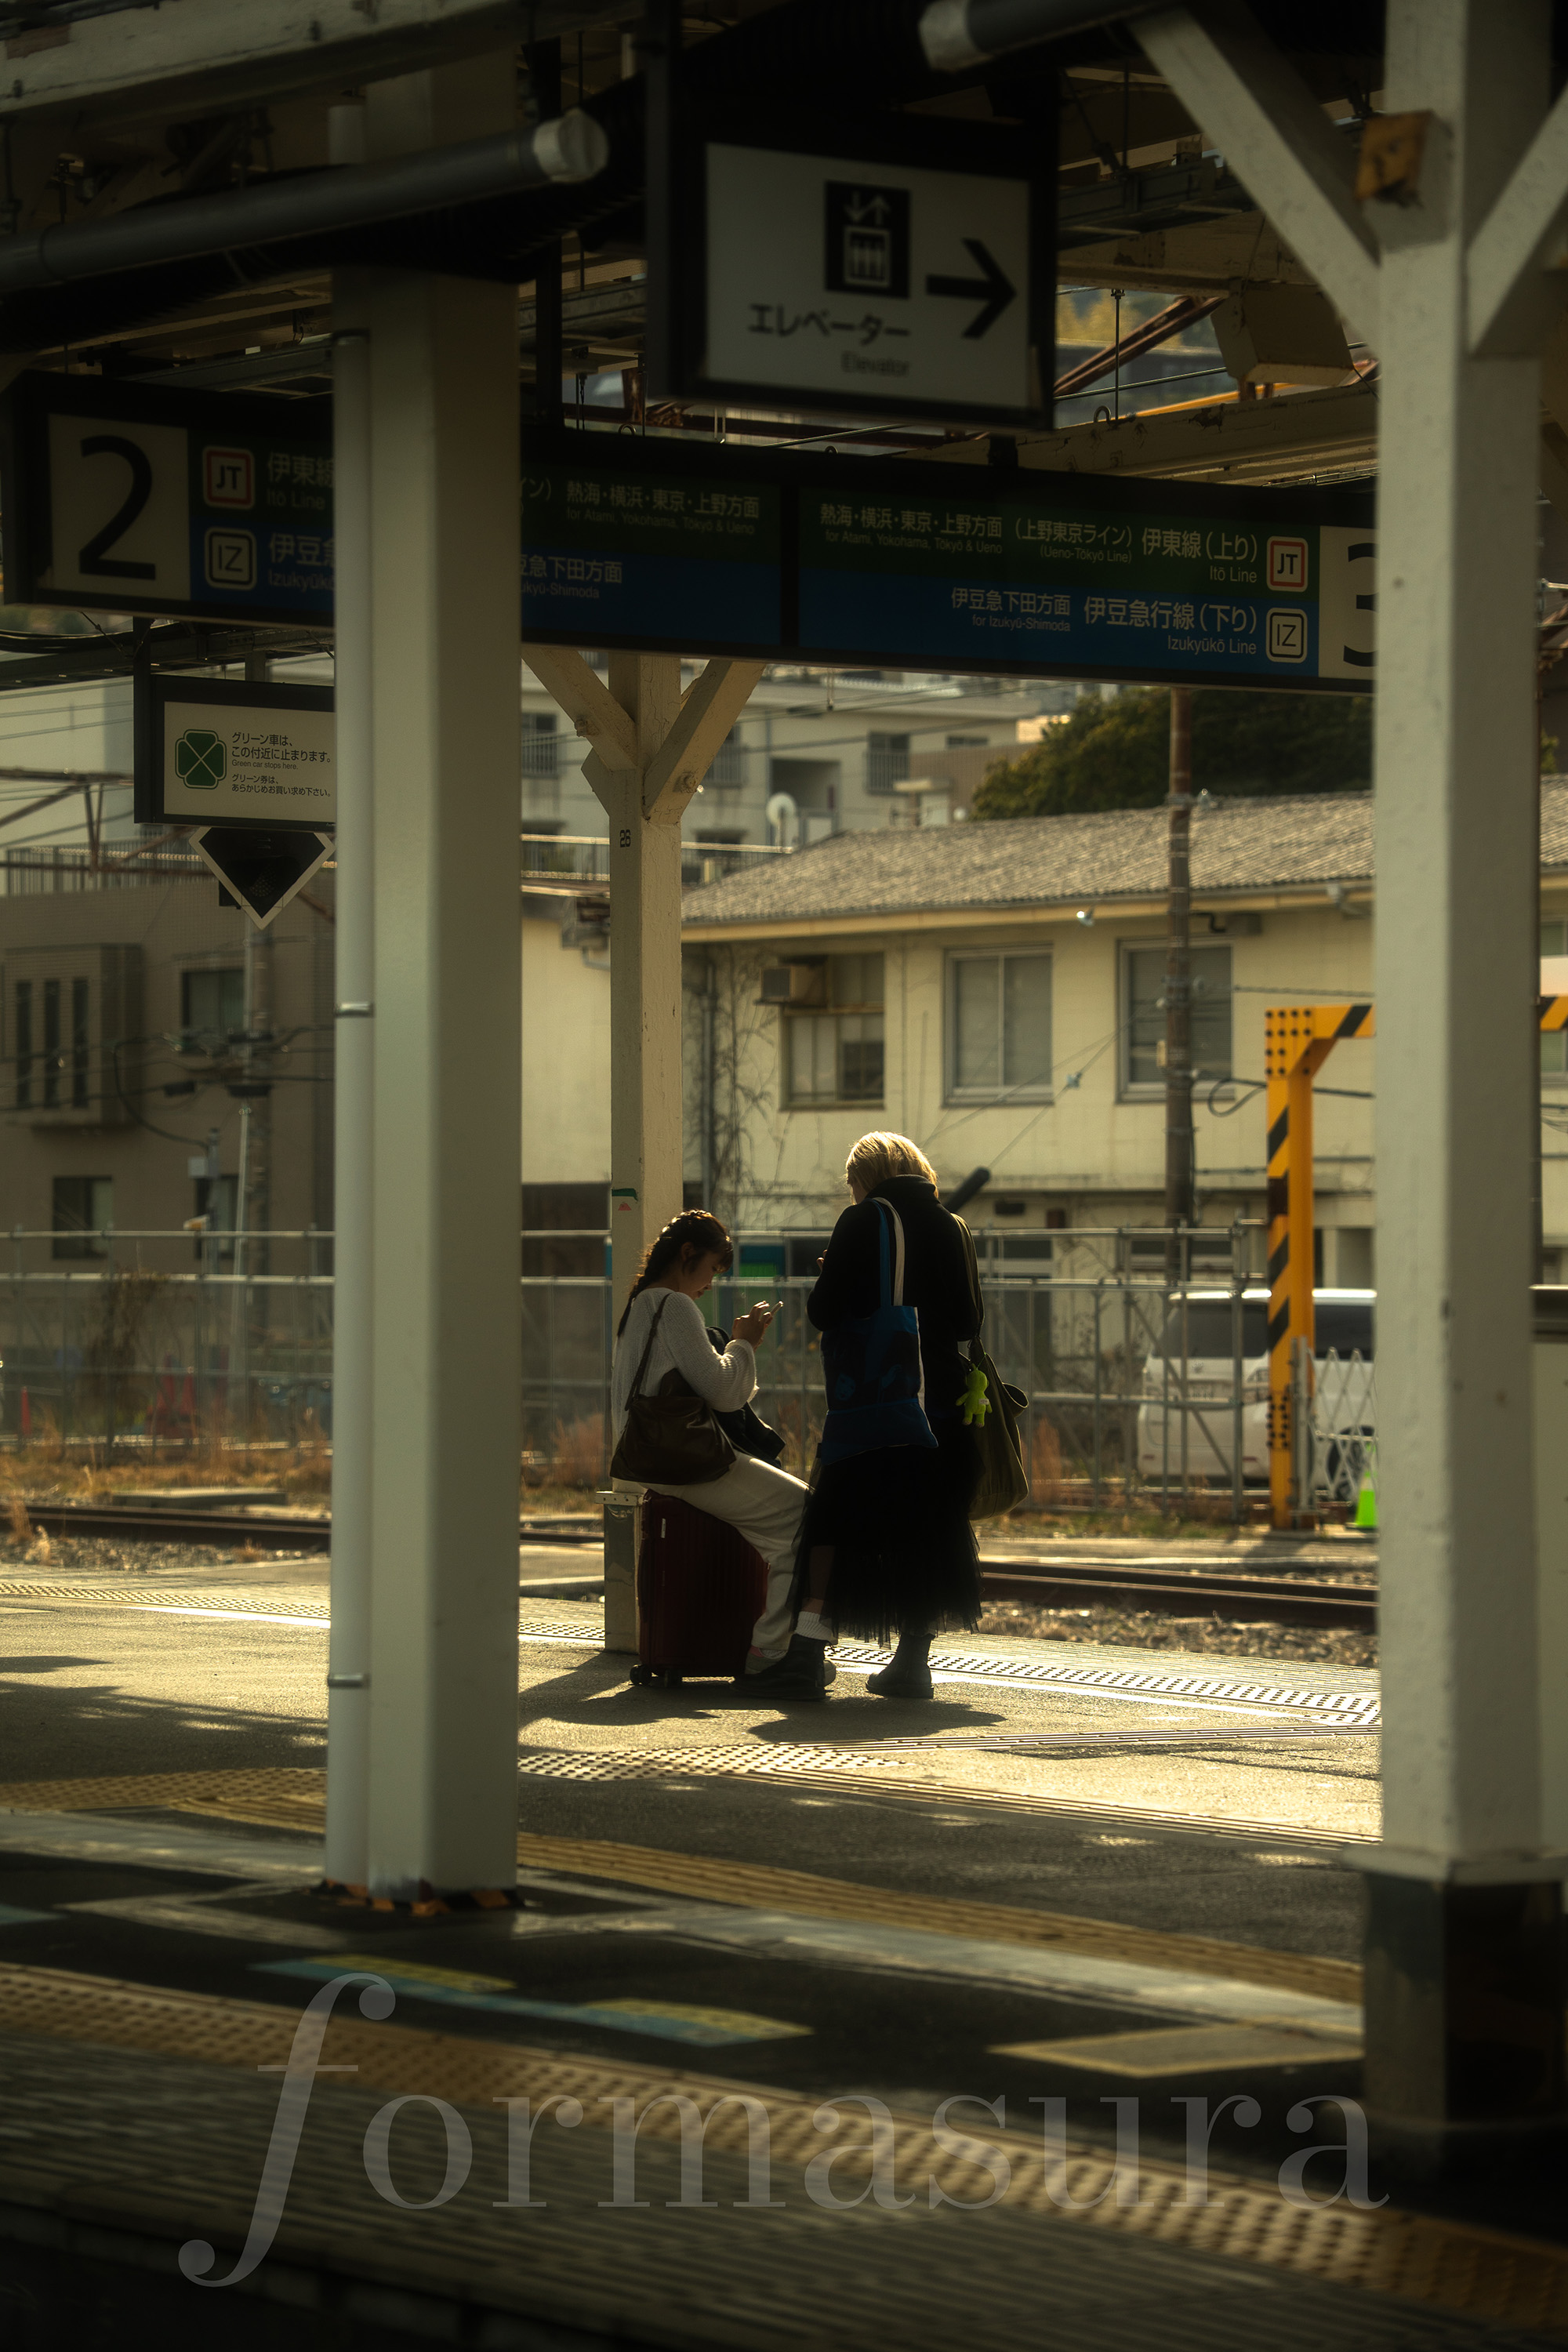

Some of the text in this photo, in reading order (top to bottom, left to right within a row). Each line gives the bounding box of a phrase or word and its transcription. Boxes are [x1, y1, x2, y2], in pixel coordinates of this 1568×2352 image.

[748, 303, 911, 347] エレベーター
[840, 350, 910, 377] Elevator
[216, 465, 241, 491] JT
[79, 435, 155, 580] 2
[291, 490, 325, 510] Line
[566, 506, 581, 521] for
[715, 519, 723, 532] &
[727, 521, 755, 535] Ueno
[826, 528, 838, 543] for
[842, 531, 873, 546] Atami,
[877, 533, 931, 550] Yokohama,
[965, 540, 973, 552] &
[976, 541, 1003, 554] Ueno
[1142, 527, 1258, 563] 伊東線（上り）
[219, 544, 242, 572] IZ
[1107, 550, 1132, 564] Line)
[1277, 554, 1298, 575] JT
[1210, 564, 1257, 583] Itō Line
[951, 586, 1258, 634] 伊豆急下田方面 伊豆急行線（下り）
[972, 613, 1071, 632] for Izukyū-Shimoda
[1167, 634, 1257, 655] Izukyūkō Line
[1276, 624, 1296, 648] IZ
[232, 732, 292, 746] グリーン車は、
[232, 746, 331, 763] この付近に止まります。
[232, 774, 279, 785] グリーン券は、
[232, 784, 331, 797] あらかじめお買い求め下さい。
[619, 829, 631, 848] 26
